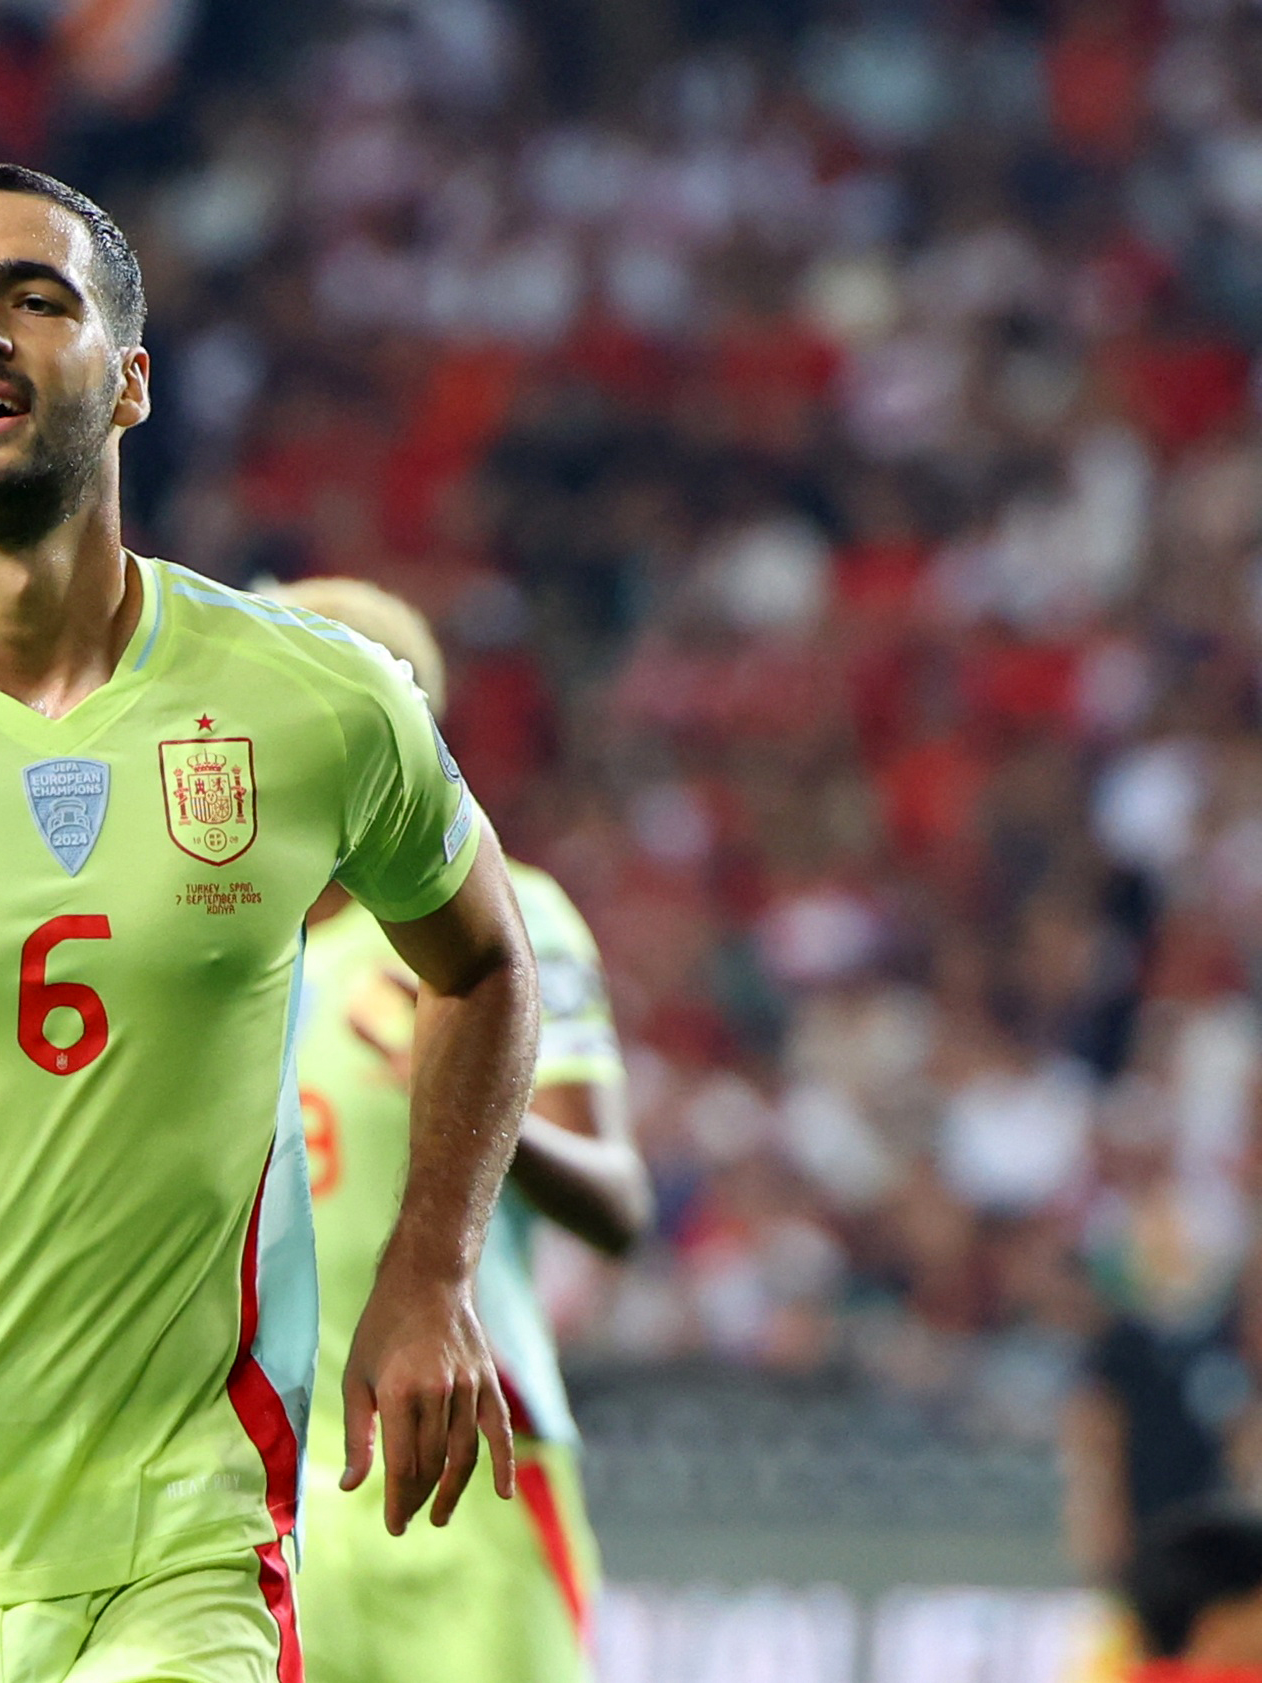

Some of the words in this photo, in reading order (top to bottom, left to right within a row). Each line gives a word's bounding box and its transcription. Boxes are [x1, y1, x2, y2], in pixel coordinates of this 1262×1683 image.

[53, 762, 80, 772] UEFA
[32, 772, 101, 786] EUROPEAN
[32, 784, 103, 797] CHAMPIONS
[53, 832, 88, 846] 2024
[186, 883, 220, 894] TURKEY
[175, 894, 182, 905] 7
[186, 893, 238, 905] SEPTEMBER
[241, 892, 262, 904] 2025
[207, 905, 236, 915] KONYA
[17, 914, 112, 1076] 6
